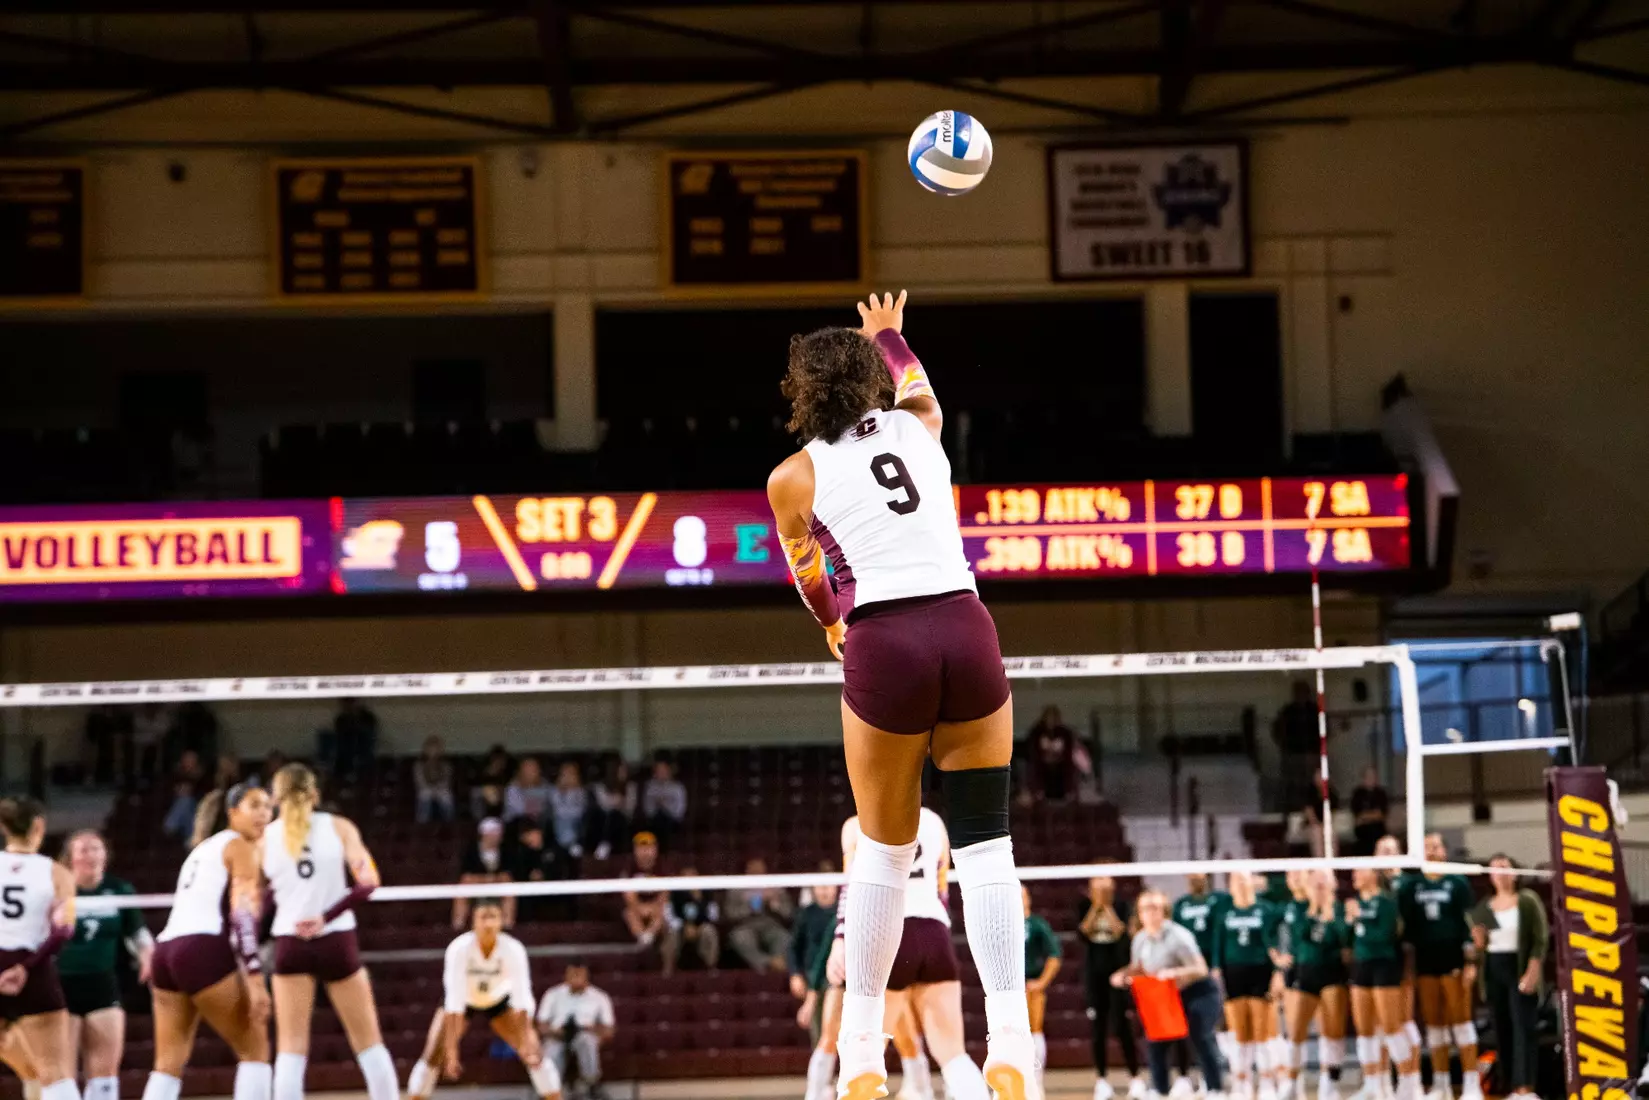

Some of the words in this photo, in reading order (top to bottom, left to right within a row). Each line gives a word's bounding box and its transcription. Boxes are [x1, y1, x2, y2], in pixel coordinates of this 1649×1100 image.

[869, 452, 921, 516] 9
[1175, 485, 1214, 520] 37
[1331, 481, 1371, 516] SA
[516, 497, 585, 543] SET
[588, 496, 617, 542] 3
[1044, 487, 1131, 523] ATK%
[4, 530, 280, 569] VOLLEYBALL
[425, 521, 461, 572] 5
[673, 515, 707, 567] 8
[735, 523, 769, 563] E
[1045, 533, 1133, 570] ATK%
[1331, 527, 1373, 563] SA
[2, 886, 25, 919] 5
